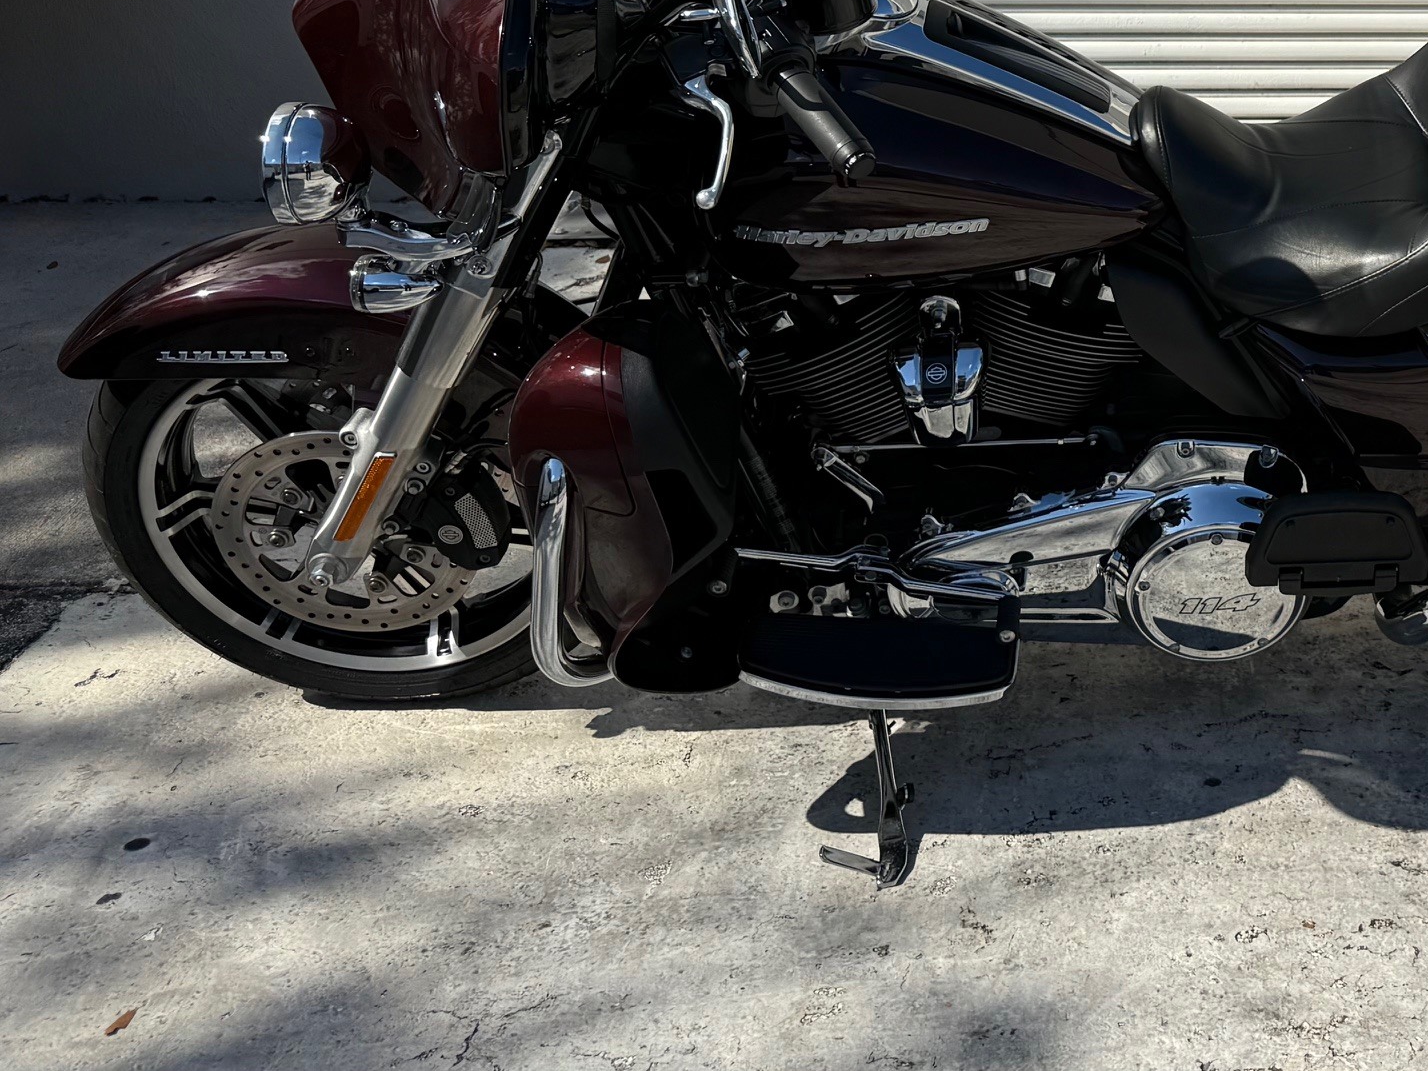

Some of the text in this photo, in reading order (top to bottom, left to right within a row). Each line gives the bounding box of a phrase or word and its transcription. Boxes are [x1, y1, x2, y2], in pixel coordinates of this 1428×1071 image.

[734, 218, 990, 247] Harley-Davidson
[159, 350, 288, 362] LIMITED
[1179, 593, 1261, 614] 114
